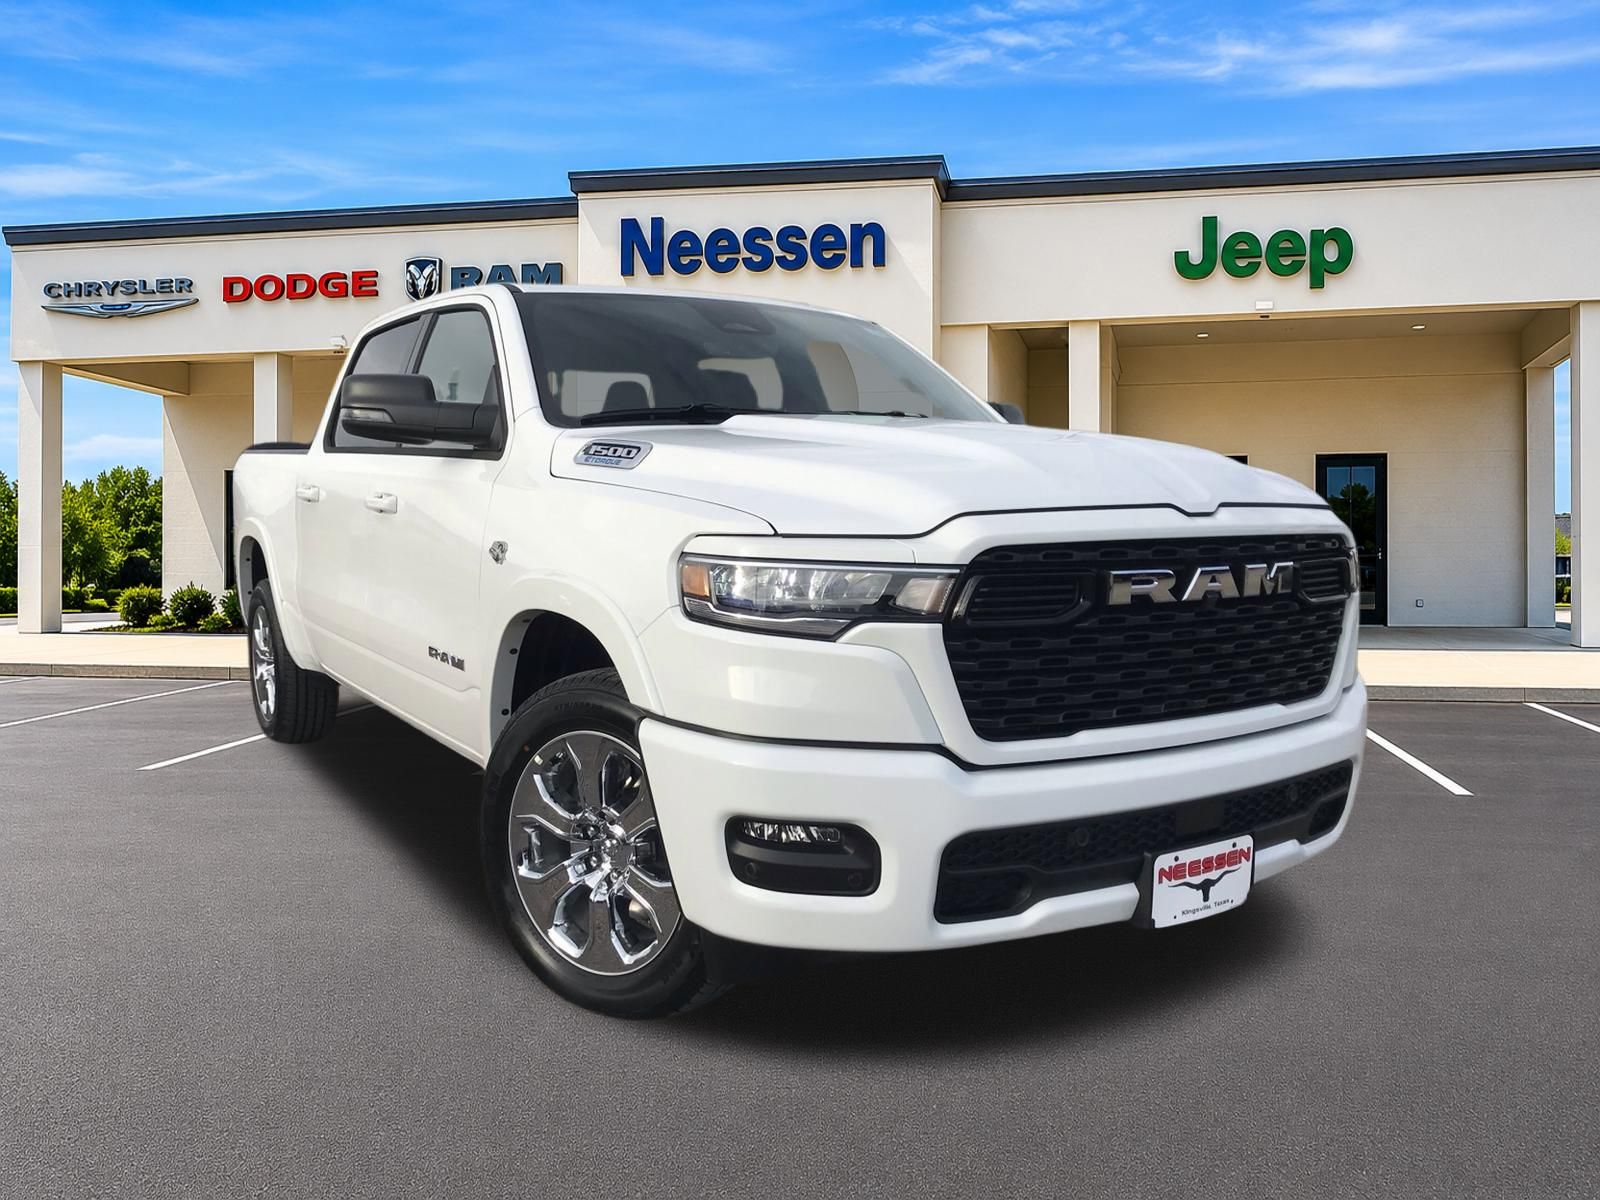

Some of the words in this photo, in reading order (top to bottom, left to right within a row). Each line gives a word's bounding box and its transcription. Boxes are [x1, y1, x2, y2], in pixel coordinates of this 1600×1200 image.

[620, 216, 886, 277] Neessen
[1174, 216, 1354, 289] Jeep
[43, 278, 194, 298] CHRYSLER
[222, 270, 379, 303] DODGE
[450, 262, 563, 291] RAM
[588, 445, 638, 458] 1500
[1108, 561, 1294, 606] RAM
[428, 645, 466, 672] RAM
[1158, 846, 1251, 884] NEESSEN
